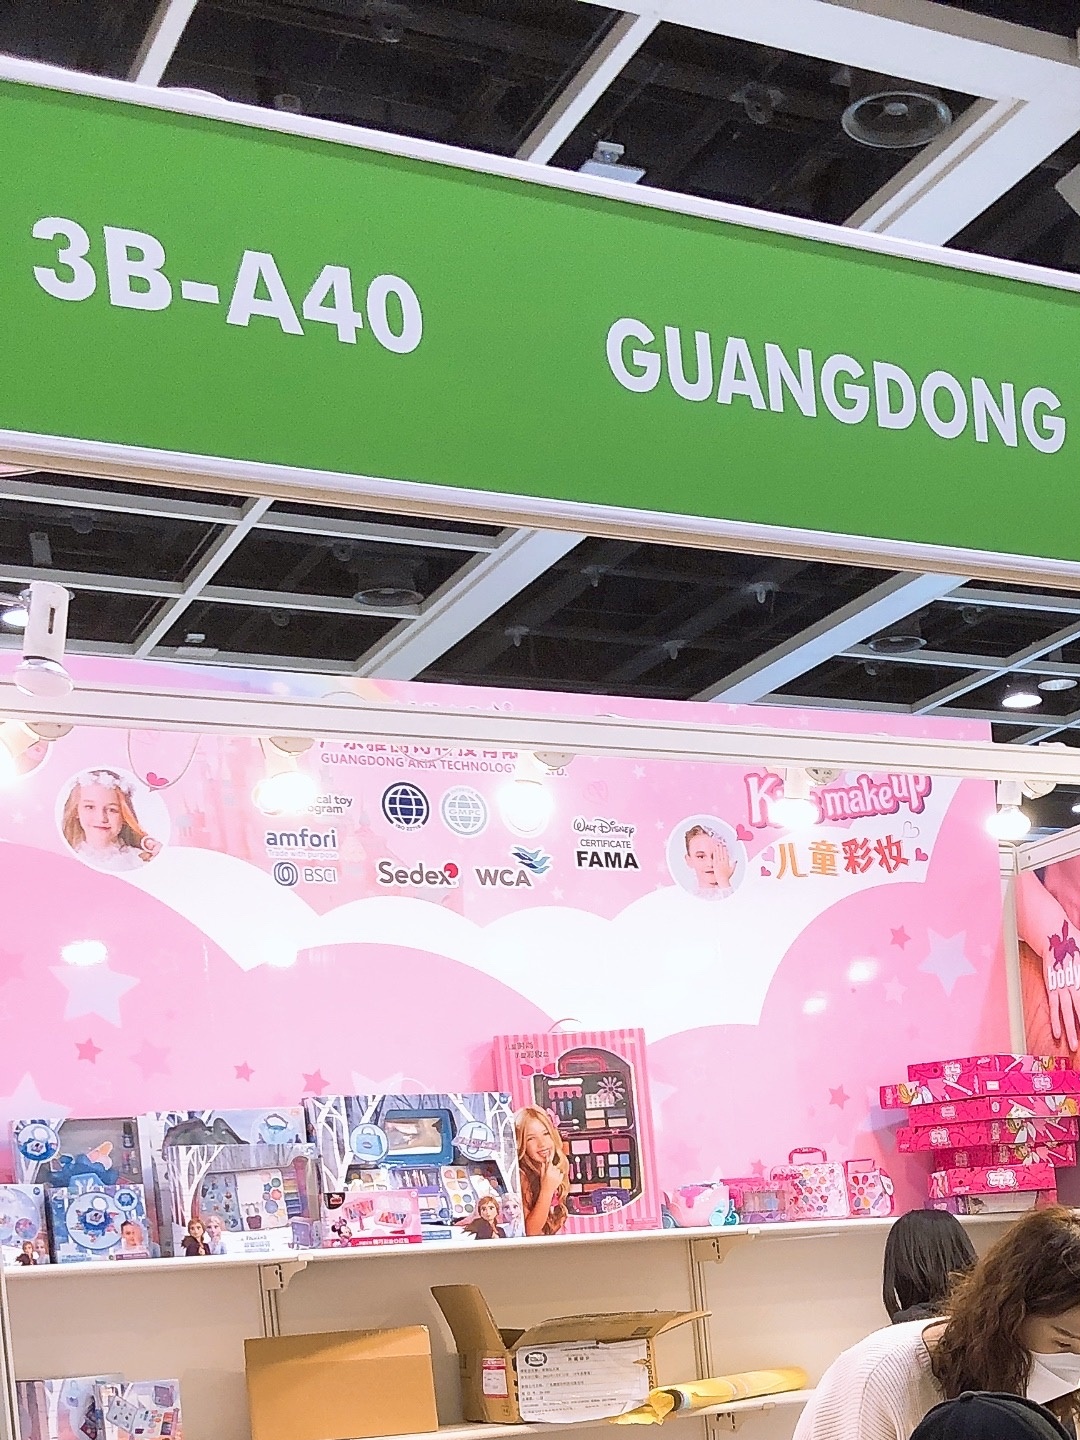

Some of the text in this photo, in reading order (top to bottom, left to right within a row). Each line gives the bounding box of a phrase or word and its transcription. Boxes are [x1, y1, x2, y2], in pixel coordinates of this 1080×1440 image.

[32, 216, 424, 355] 3B-A40
[606, 317, 1066, 455] GUANGDONG
[320, 753, 404, 769] GUANGDONG
[266, 828, 337, 848] amfori
[580, 838, 632, 849] CERTIFICATE
[576, 850, 640, 869] FAMA
[776, 835, 910, 880] 儿童彩妆
[304, 868, 337, 882] BSCI
[377, 861, 452, 885] Sedex
[475, 867, 532, 887] WCA
